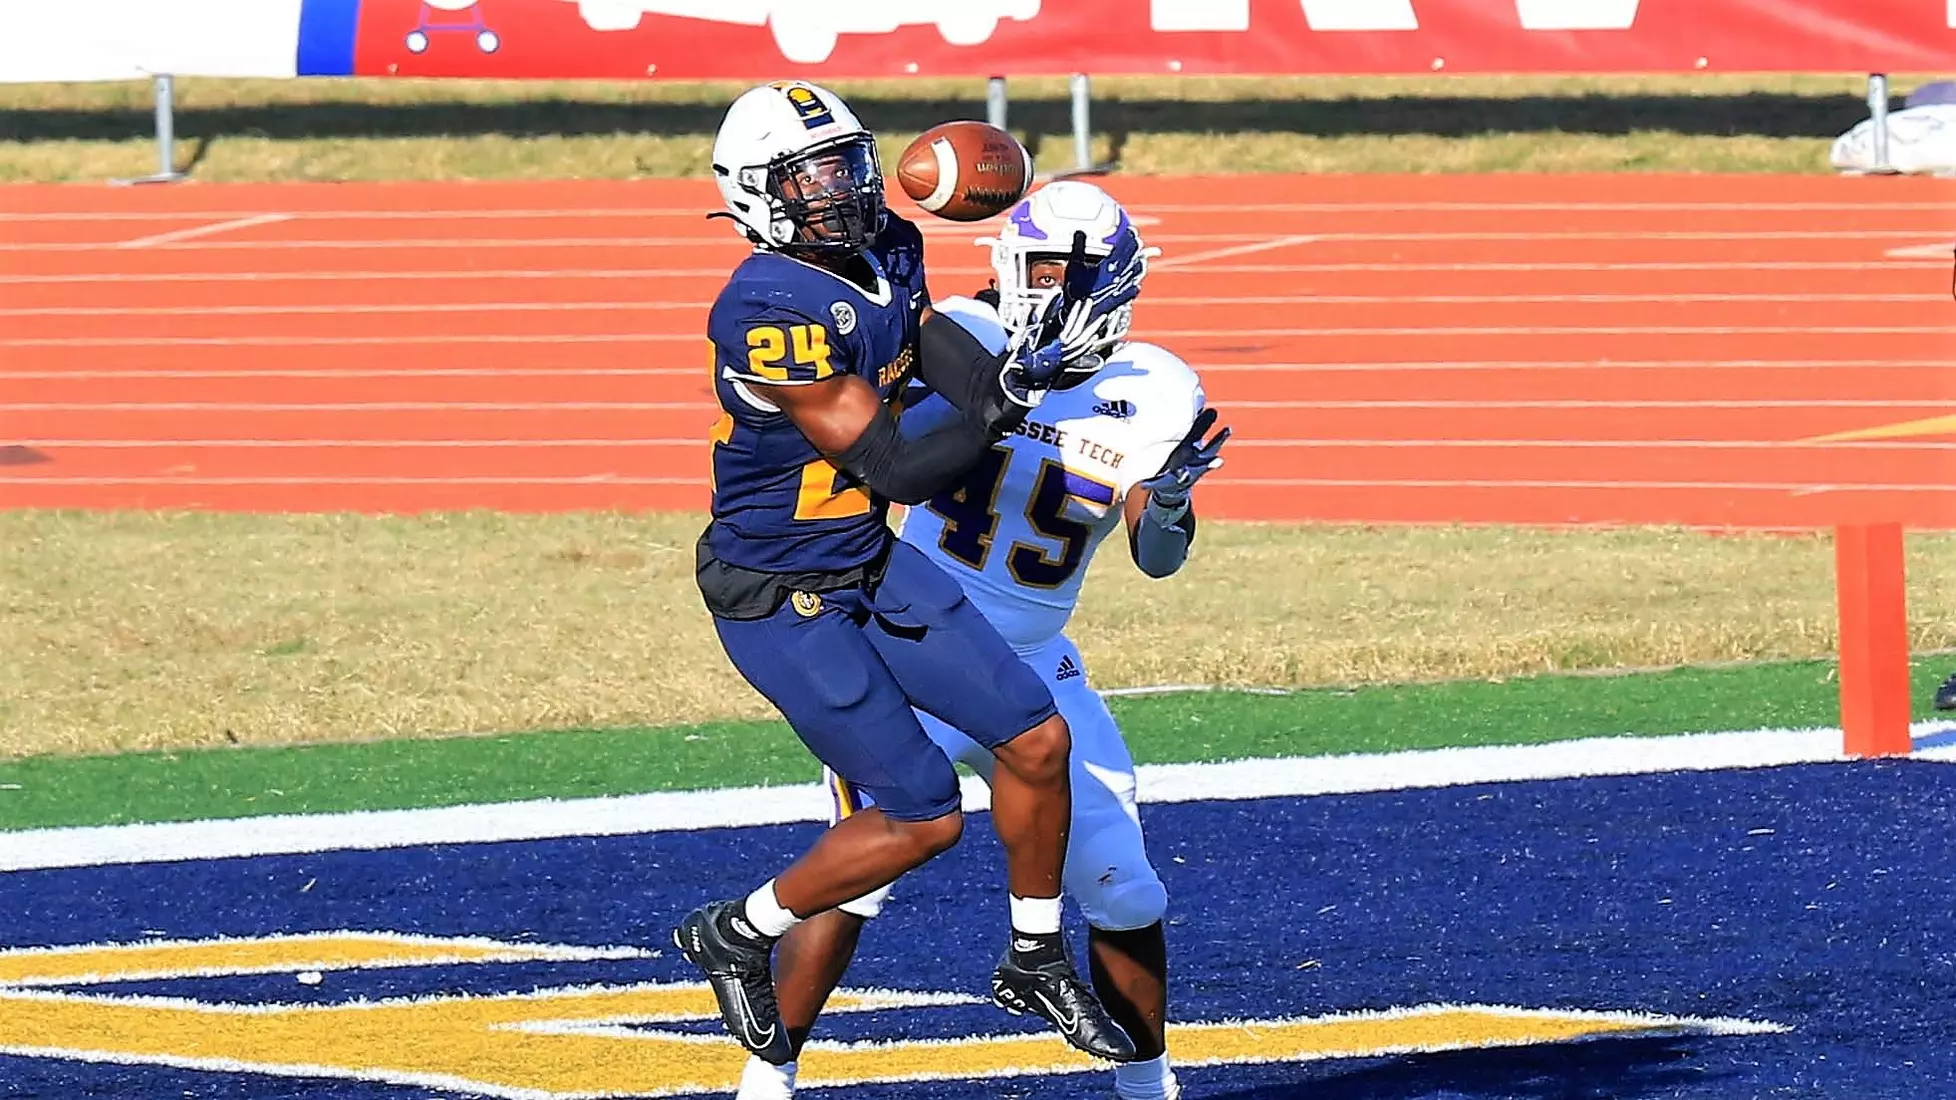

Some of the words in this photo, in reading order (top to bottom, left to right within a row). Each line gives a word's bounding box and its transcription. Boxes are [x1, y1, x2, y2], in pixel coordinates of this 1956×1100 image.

[746, 324, 834, 381] 24
[1014, 419, 1069, 448] SSEE
[1079, 438, 1125, 470] TECH
[925, 444, 1120, 589] 45
